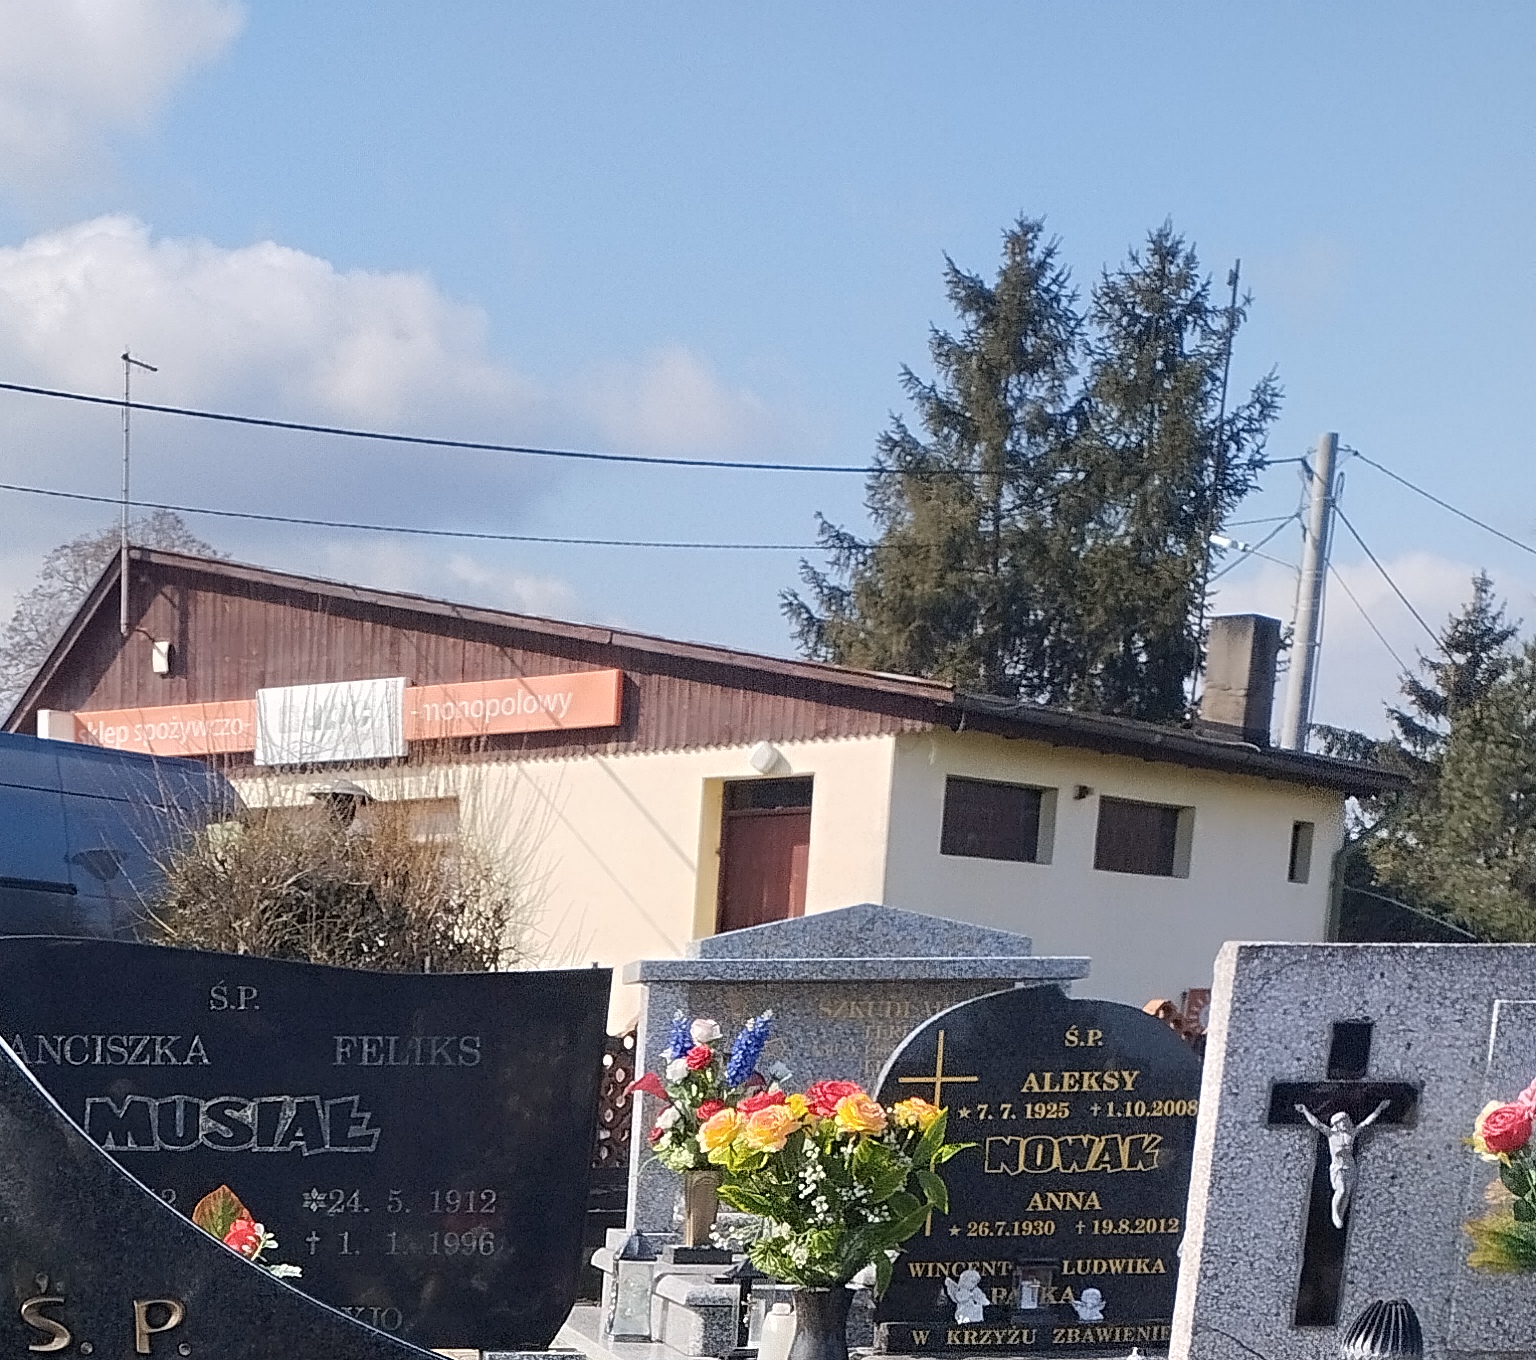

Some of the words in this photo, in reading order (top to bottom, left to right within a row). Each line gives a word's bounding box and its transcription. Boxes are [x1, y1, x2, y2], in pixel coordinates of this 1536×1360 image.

[78, 719, 129, 749] sklep
[1064, 1025, 1104, 1048] Ś.P.
[13, 1034, 213, 1067] ANCISZKA
[332, 1034, 482, 1068] FELIKS
[1020, 1069, 1141, 1094] ALEKSY
[1025, 1102, 1071, 1120] 1925
[984, 1133, 1165, 1177] NOWAK
[327, 1188, 370, 1216] 24.
[387, 1188, 412, 1215] 5.
[430, 1188, 498, 1215] 1912
[1025, 1191, 1104, 1213] ANNA
[967, 1219, 1056, 1238] 26.7.1930
[1091, 1217, 1180, 1237] 19.8.2012
[429, 1230, 497, 1257] 1996
[1062, 1258, 1167, 1277] LUDWIKA
[912, 1329, 930, 1346] W
[947, 1325, 1038, 1346] KRZYŻU
